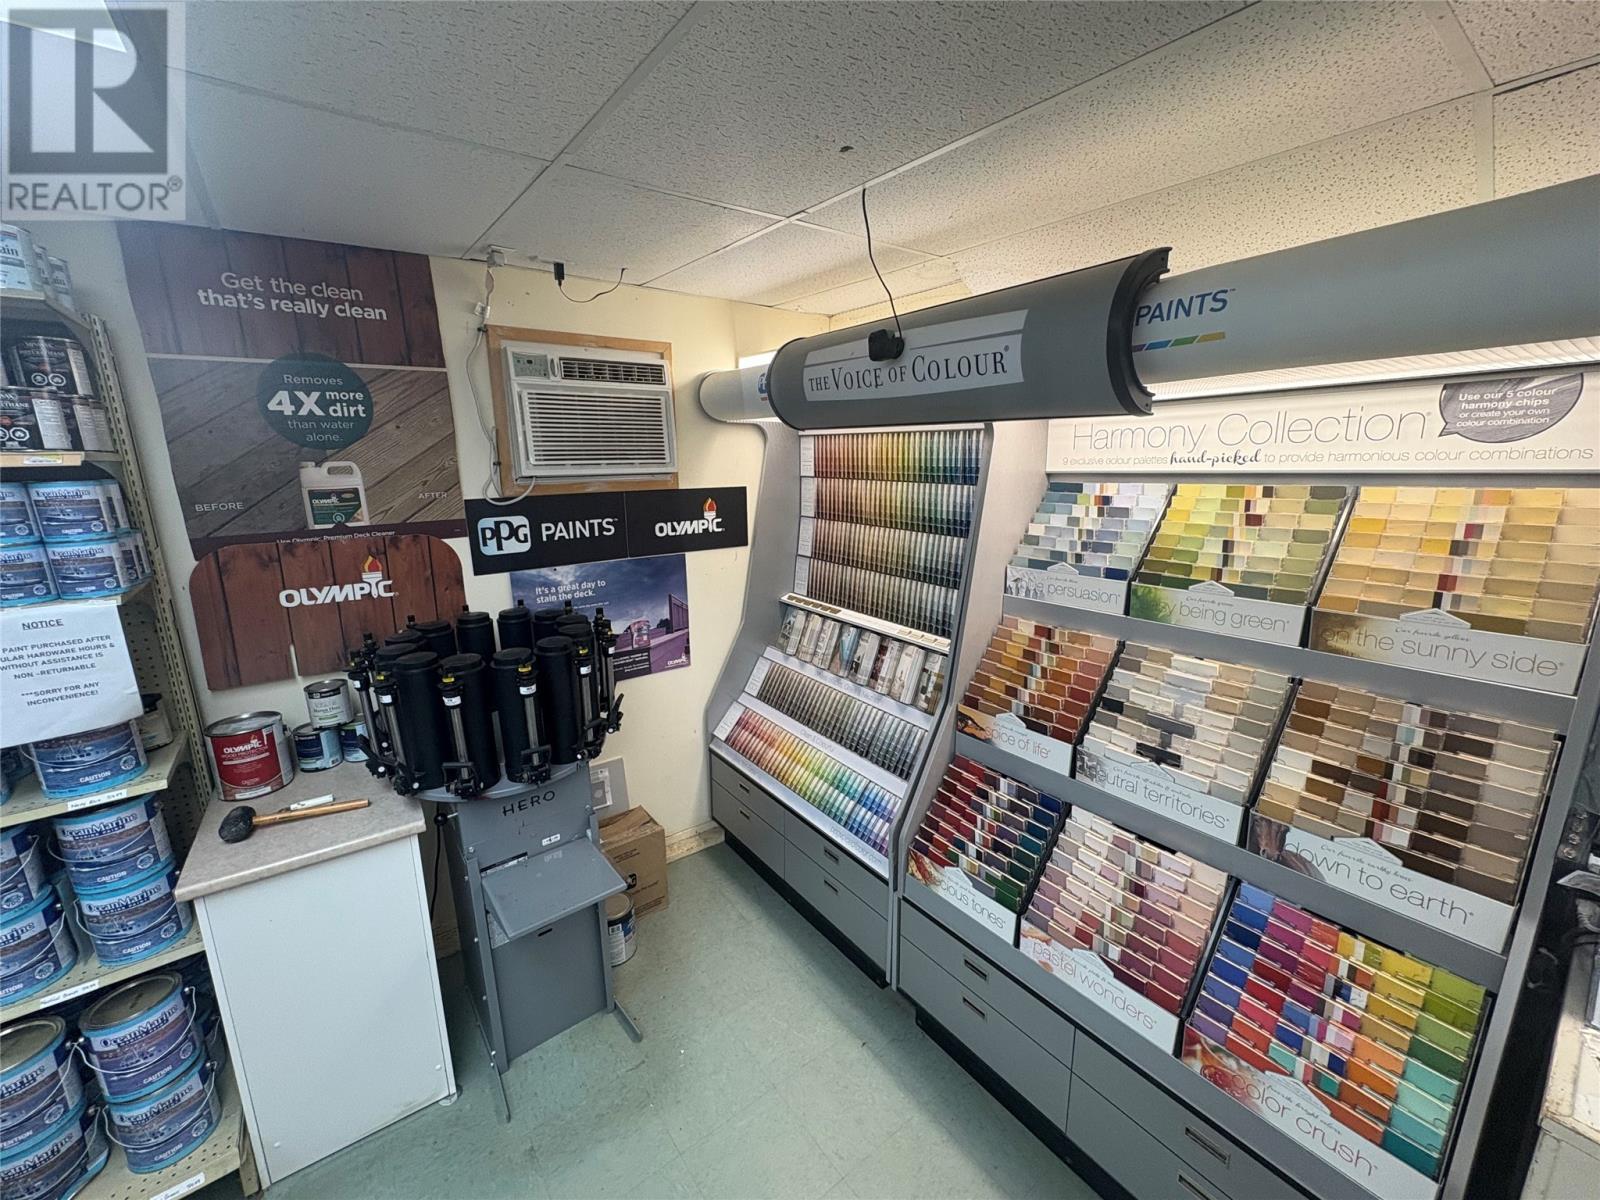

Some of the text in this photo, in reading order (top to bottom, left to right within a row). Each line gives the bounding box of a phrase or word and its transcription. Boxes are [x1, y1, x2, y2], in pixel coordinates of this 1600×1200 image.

[220, 272, 363, 301] Get the clean
[197, 289, 388, 321] that's really clean
[283, 374, 343, 385] Removes
[808, 375, 831, 391] THE
[831, 367, 884, 391] VOICE
[888, 366, 907, 384] OF
[326, 391, 364, 401] more
[1506, 390, 1514, 398] 5
[1515, 387, 1557, 398] colour
[267, 390, 326, 416] 4X
[328, 402, 367, 417] dirt
[1461, 398, 1549, 411] harmony chips
[1456, 417, 1549, 427] colour combination
[1472, 410, 1500, 418] create
[1502, 410, 1525, 419] your
[288, 419, 354, 429] than water
[306, 432, 344, 442] alone.
[1073, 423, 1207, 454] Harmony
[1133, 455, 1168, 466] palettes
[1170, 449, 1262, 467] hand-picked
[1264, 454, 1276, 463] to
[1278, 451, 1324, 465] provide
[1327, 449, 1410, 462] harmonious
[1414, 449, 1467, 462] colour
[1469, 446, 1594, 461] combinations
[418, 491, 448, 500] AFTER
[195, 502, 244, 512] BEFORE
[654, 514, 723, 537] OLYMPIC
[480, 519, 530, 552] PPG
[279, 576, 396, 608] OLYMPIC
[535, 579, 606, 595] It's a great day to
[536, 588, 596, 604] stain the deck.
[1047, 582, 1121, 604] persuasion
[22, 618, 64, 630] NOTICE
[1179, 601, 1227, 625] being
[1230, 610, 1290, 633] green
[3, 635, 111, 653] PAINT PURCHASED AFTER
[27, 647, 76, 660] HARDWARE
[78, 643, 108, 653] HOURS
[1319, 627, 1350, 644] on
[1356, 626, 1394, 651] the
[1400, 637, 1486, 668] sunny
[1490, 651, 1559, 677] side
[41, 653, 94, 666] ASSISTANCE
[13, 671, 34, 680] NON
[64, 684, 81, 692] FOR
[83, 681, 100, 690] ANY
[224, 738, 262, 754] OLYMPIC
[984, 724, 1016, 746] spice
[1018, 734, 1031, 751] of
[1032, 737, 1050, 758] life
[80, 770, 111, 783] CAUTION
[502, 790, 556, 817] HERO
[1143, 785, 1227, 830] territories
[62, 812, 138, 837] OceanMarine
[97, 871, 127, 882] CAUTION
[1284, 841, 1351, 879] down
[1357, 867, 1383, 891] to
[1389, 882, 1471, 925] earth
[87, 884, 162, 912] OceanMarine
[970, 899, 1004, 931] tones
[123, 941, 151, 954] CAUTION
[1032, 940, 1077, 978] pastel
[1079, 973, 1155, 1031] wonders
[100, 1004, 180, 1048] OceanMarine
[143, 1065, 173, 1084] CAUTION
[1295, 1116, 1374, 1176] crush
